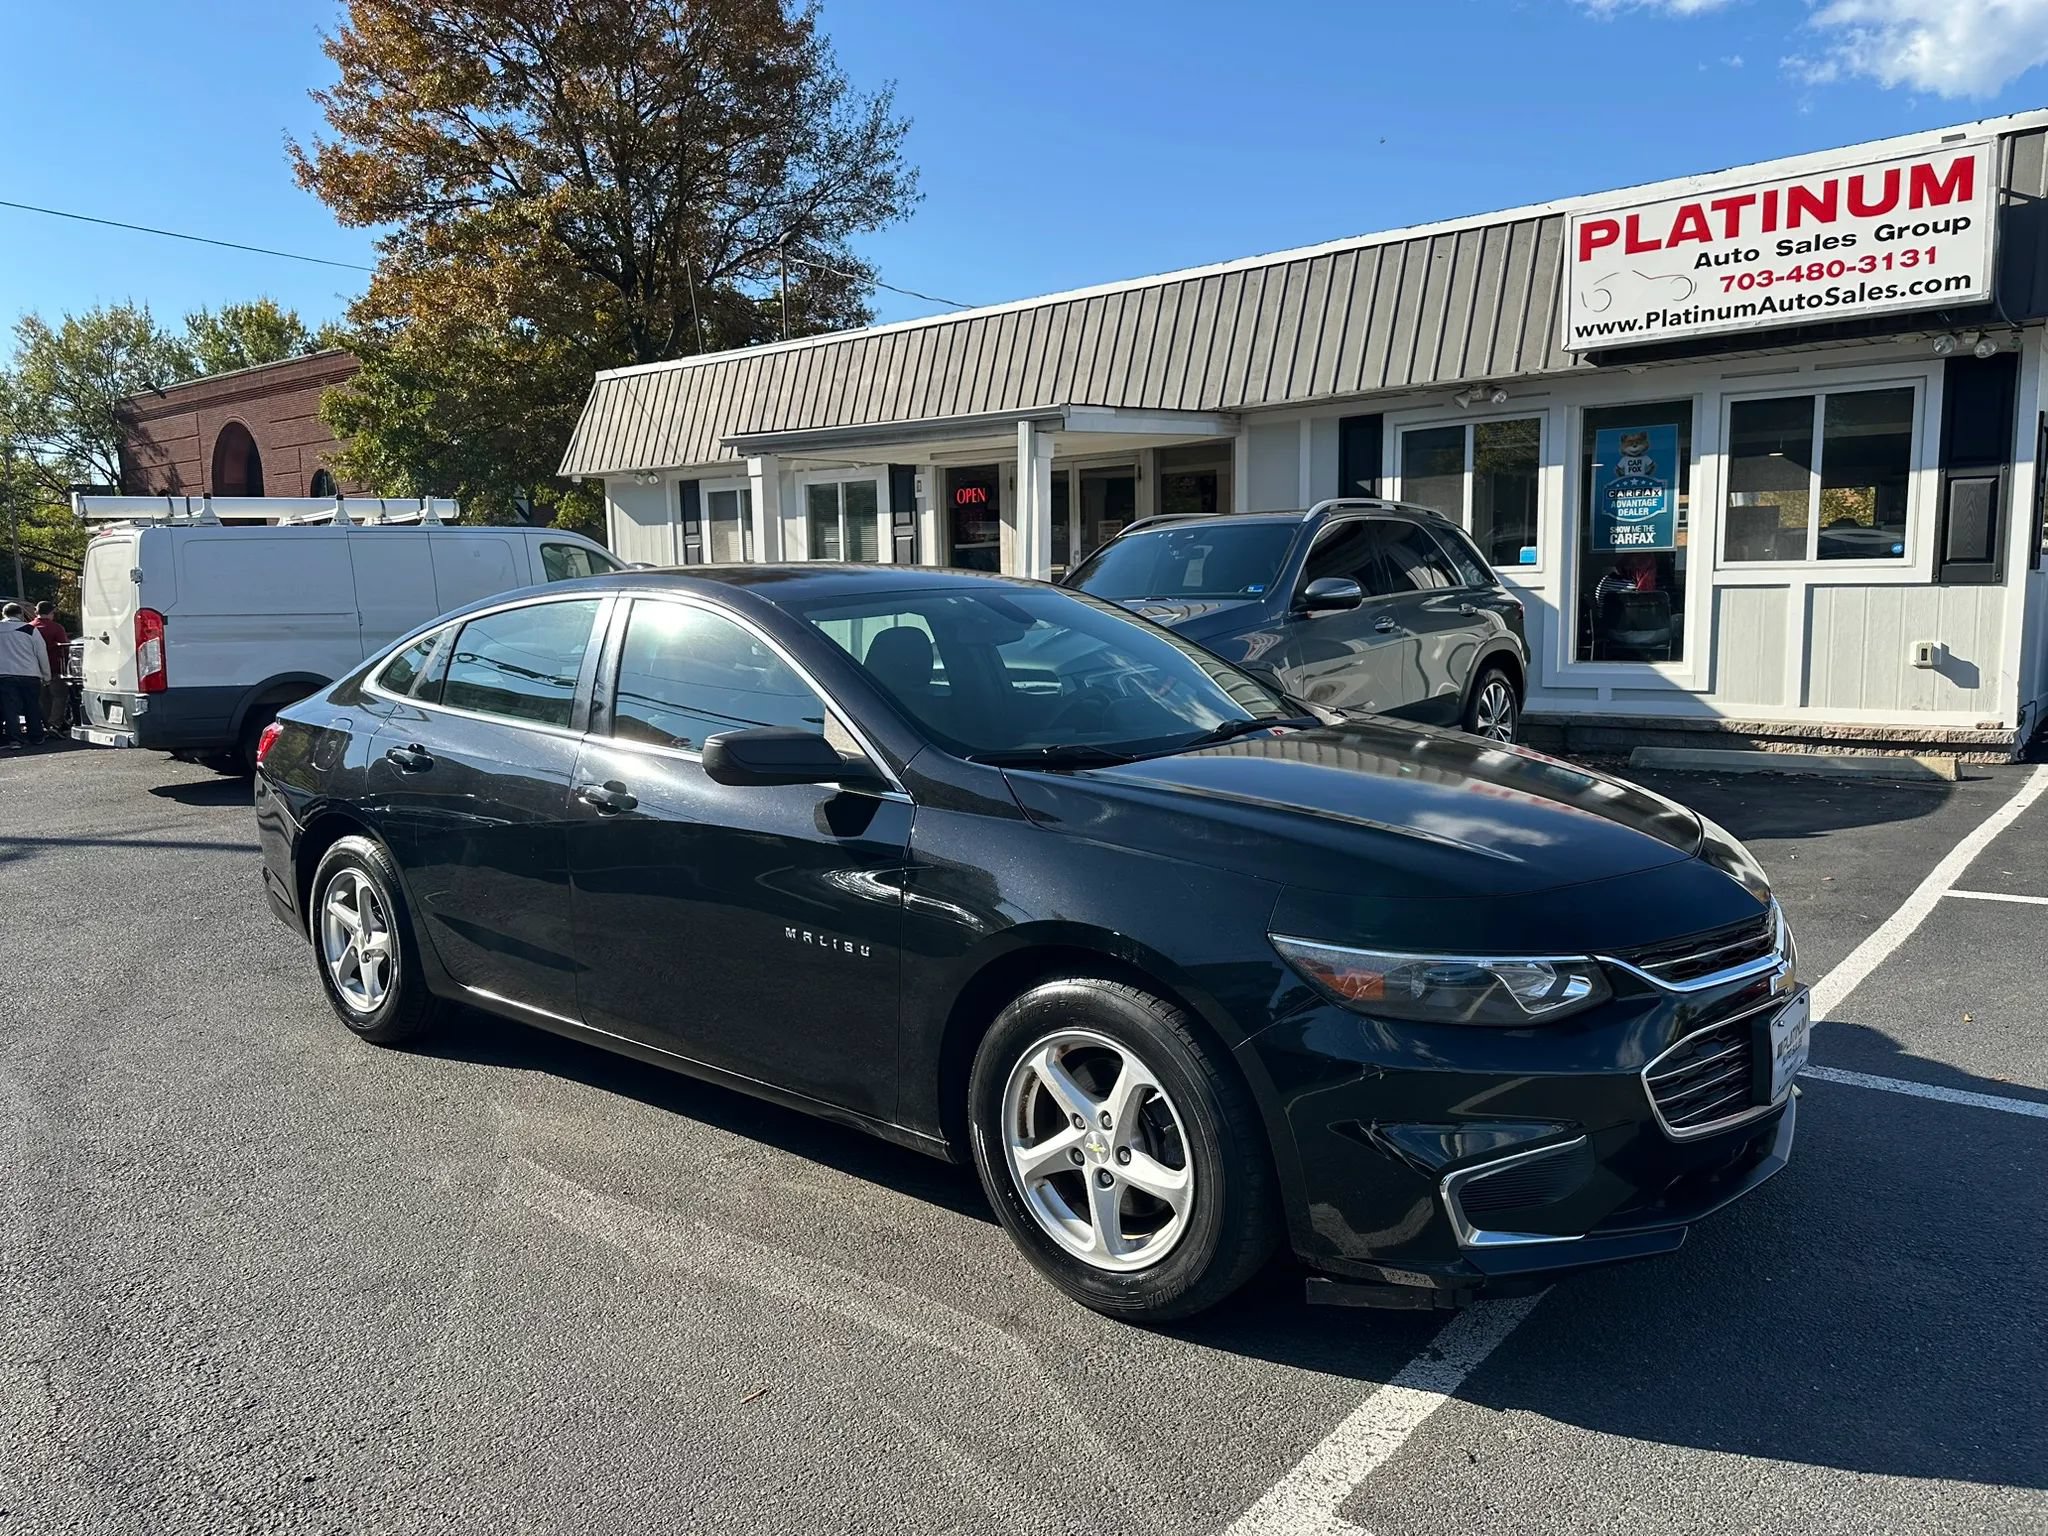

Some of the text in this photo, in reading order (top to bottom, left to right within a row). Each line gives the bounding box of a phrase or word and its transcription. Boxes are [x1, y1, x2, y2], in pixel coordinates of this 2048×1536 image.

[1579, 155, 1975, 262] PLATINUM
[1693, 216, 1972, 270] Auto Sales Group
[1719, 246, 1937, 293] 703-480-3131
[1575, 274, 1972, 338] www.PlatinumAutoSales.com
[956, 487, 986, 504] OPEN
[1609, 488, 1662, 497] CARFAX
[1611, 498, 1658, 508] ADVANTAGE
[1617, 508, 1649, 516] DEALER
[1609, 524, 1655, 533] SHOW ME THE
[1609, 533, 1655, 545] CARFAX
[784, 926, 870, 957] MALIBU
